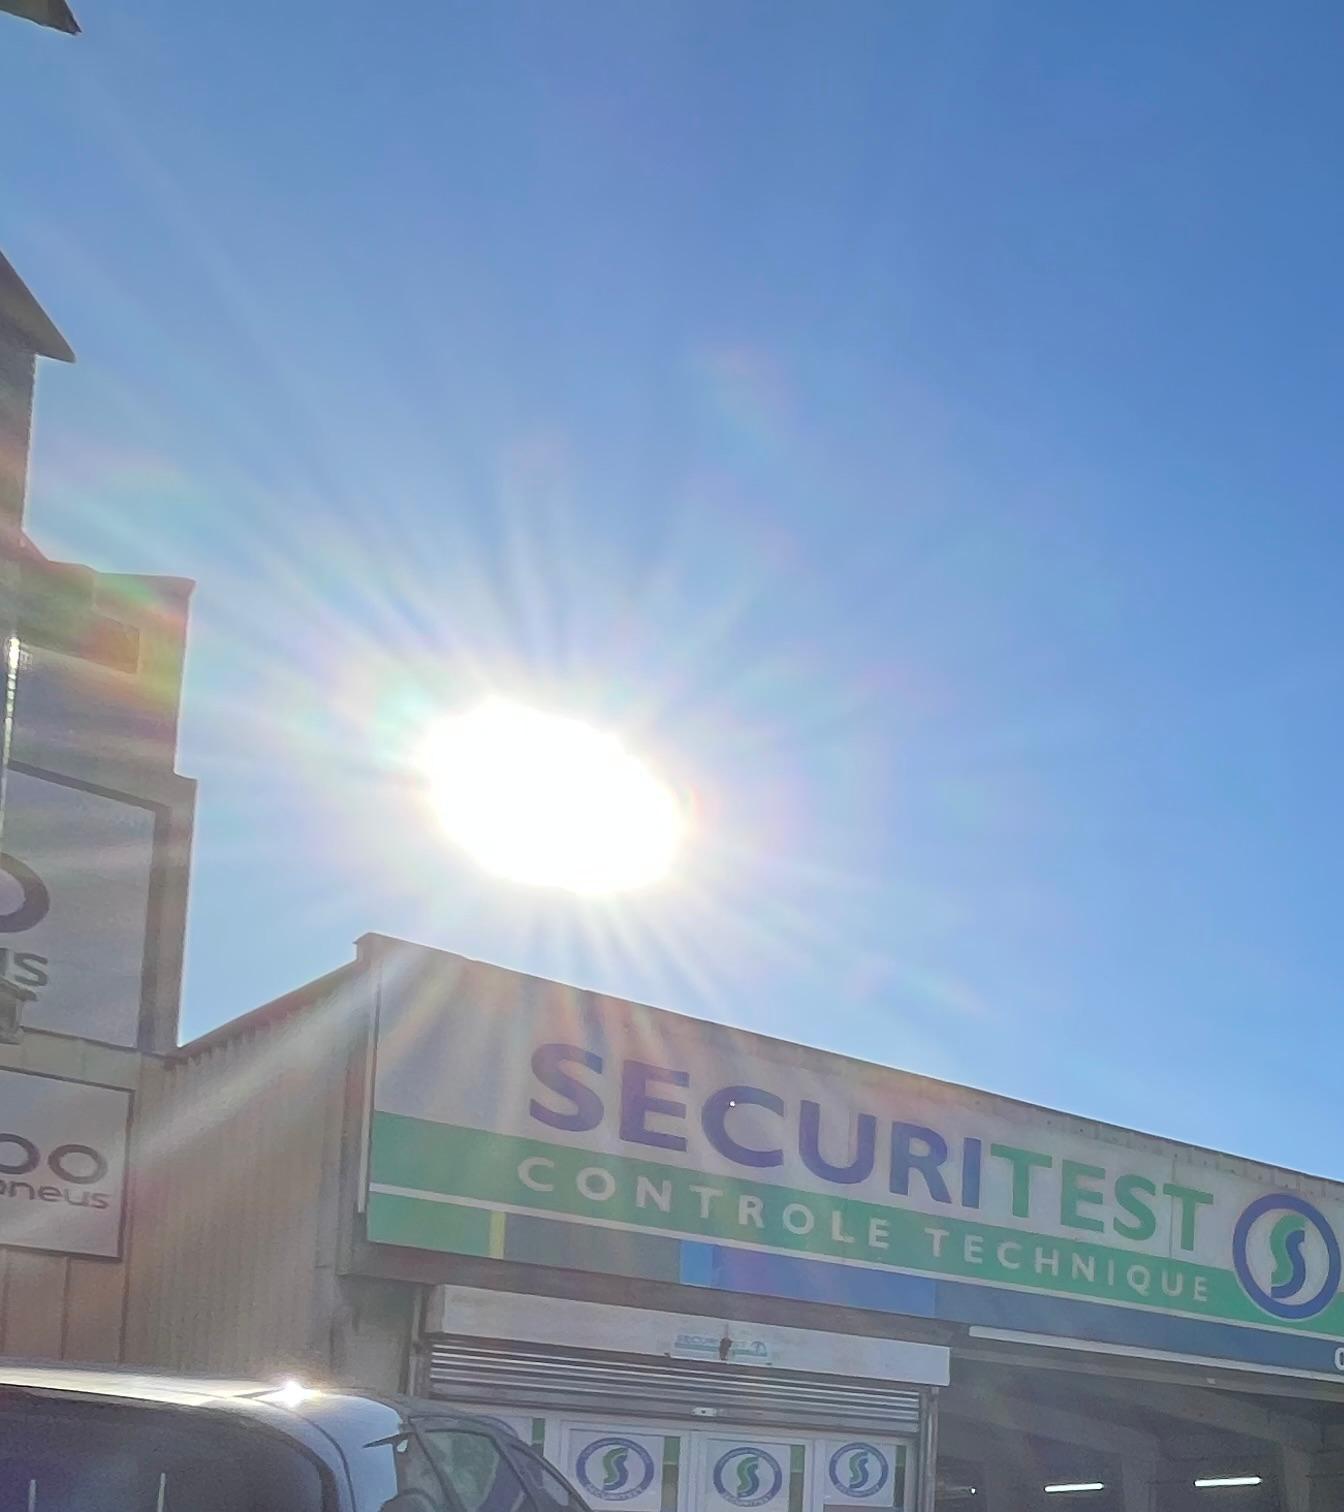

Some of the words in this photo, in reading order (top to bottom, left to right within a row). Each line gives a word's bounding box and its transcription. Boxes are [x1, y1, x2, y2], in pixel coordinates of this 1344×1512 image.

[517, 1156, 890, 1250] CONTROLE
[924, 1226, 1209, 1303] TECHNIQUE
[529, 1043, 1214, 1253] SECURITEST
